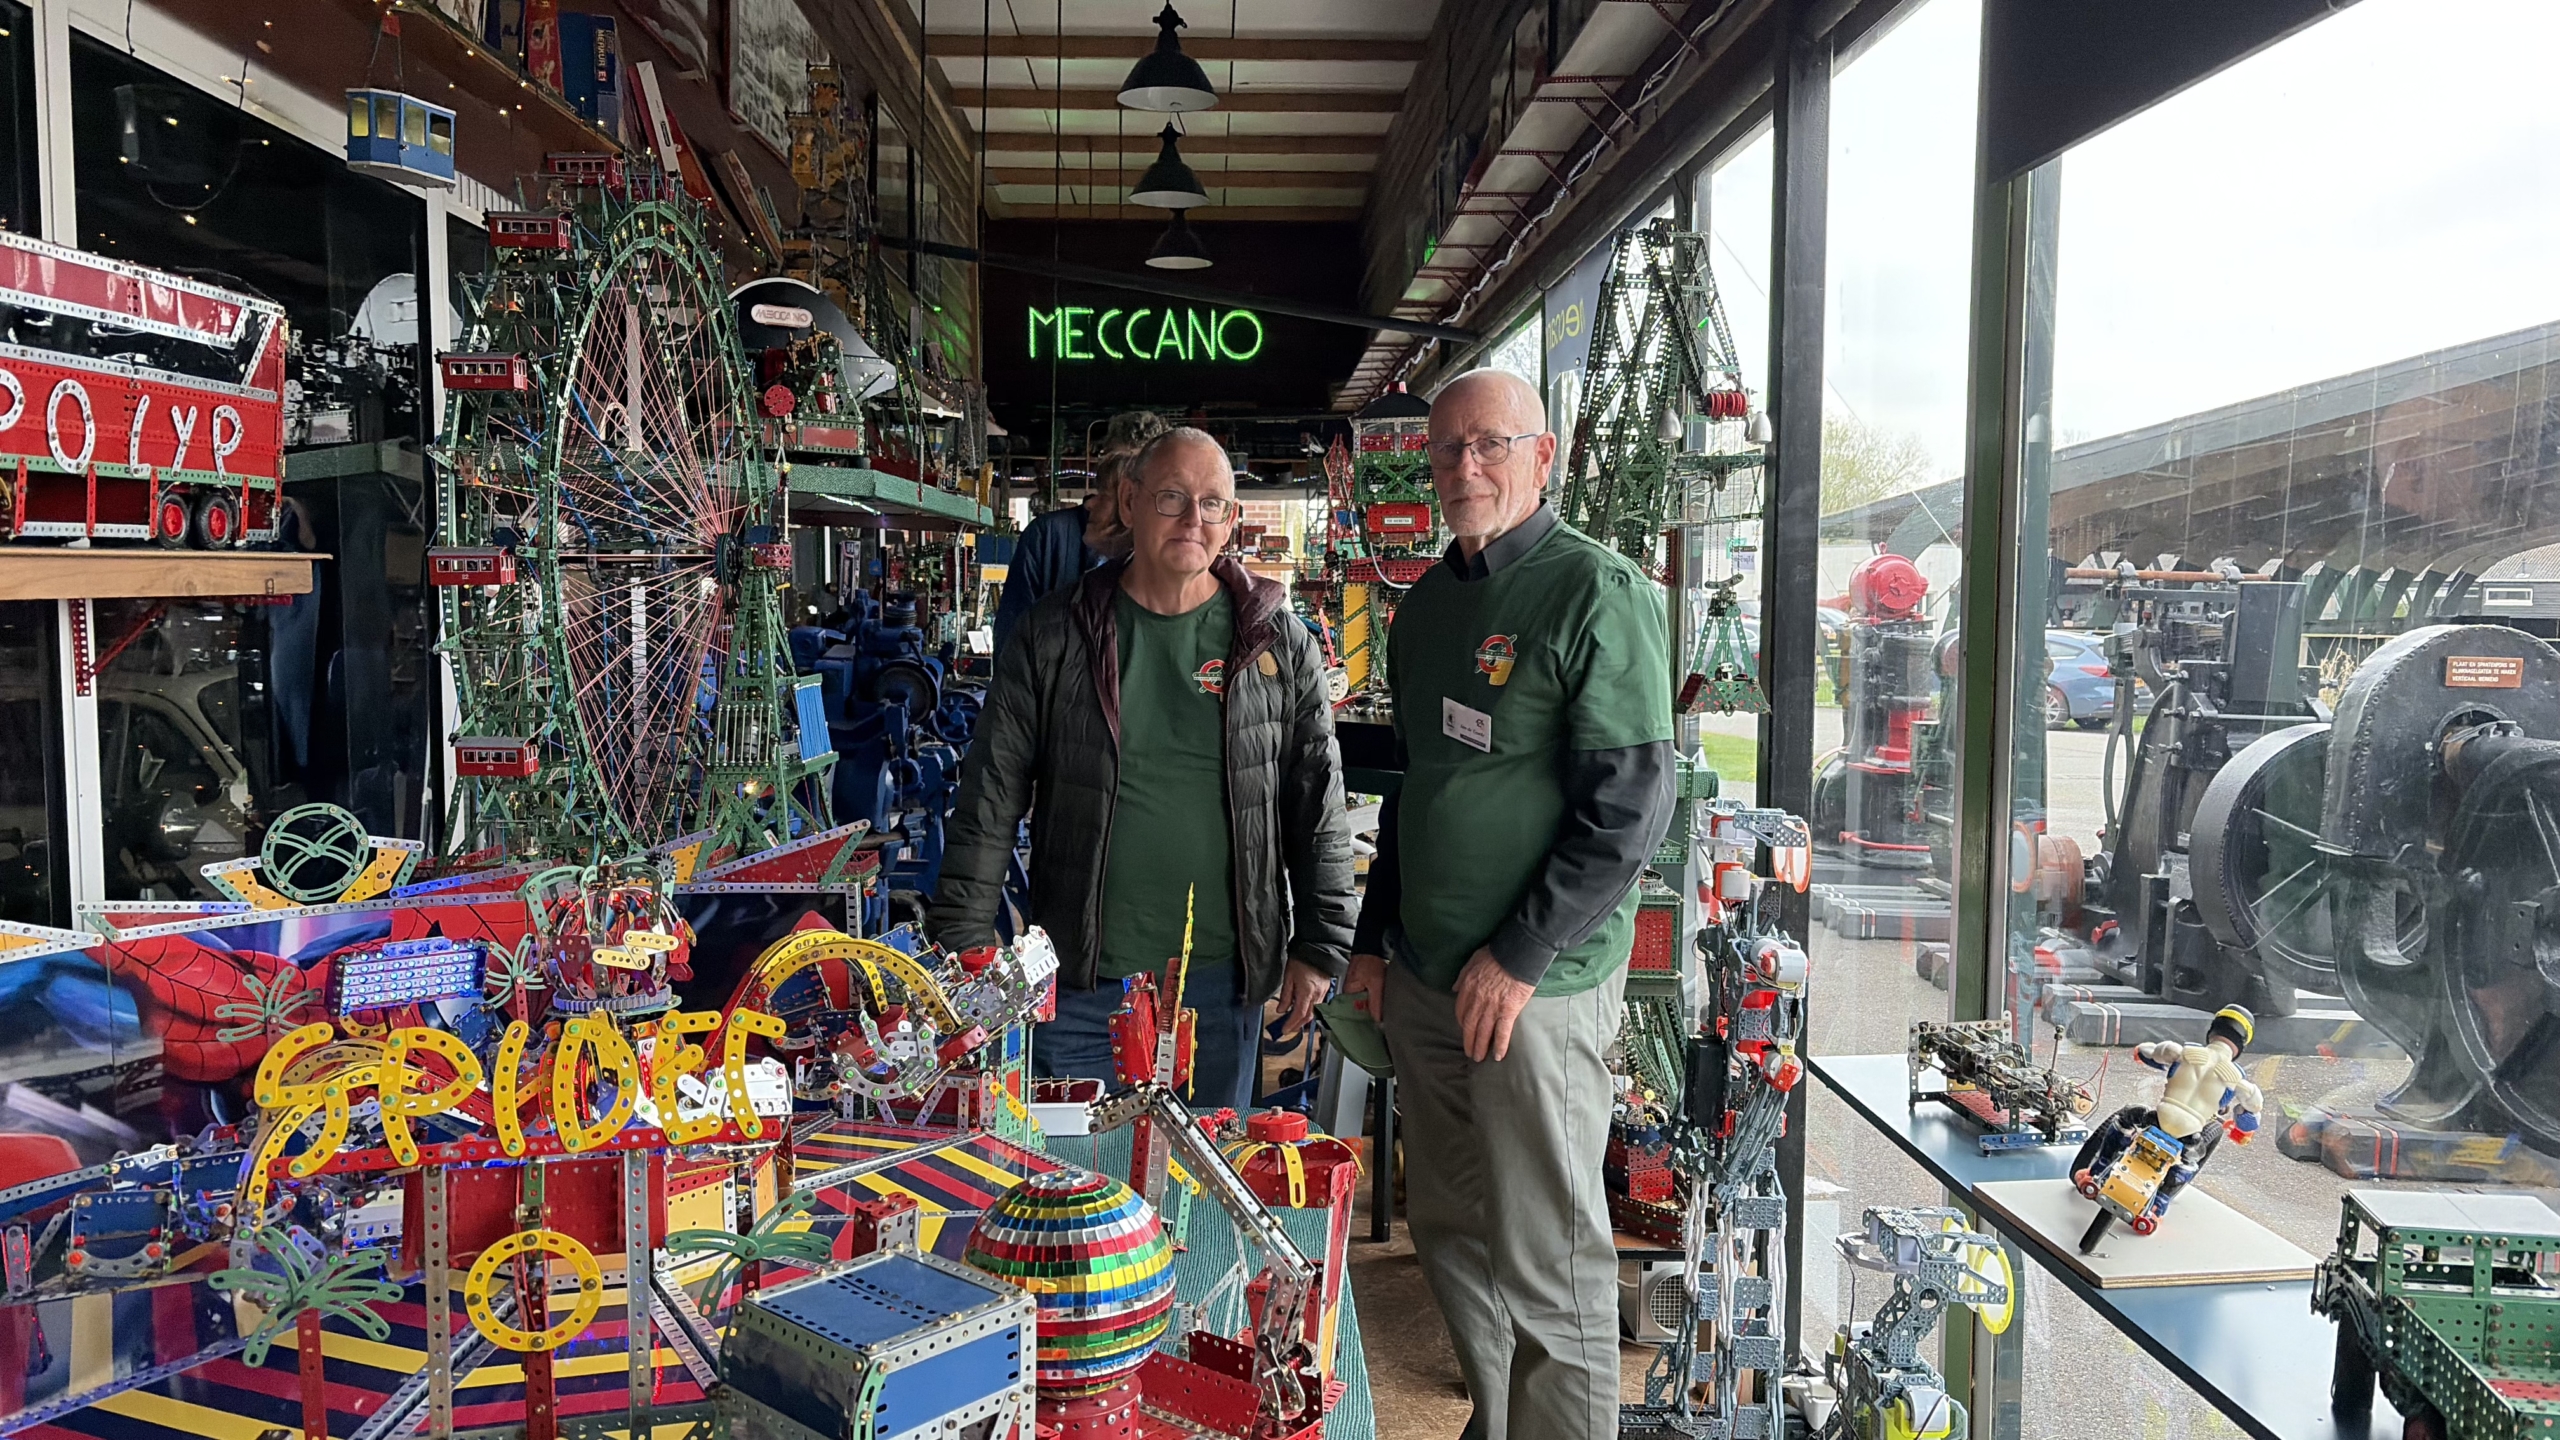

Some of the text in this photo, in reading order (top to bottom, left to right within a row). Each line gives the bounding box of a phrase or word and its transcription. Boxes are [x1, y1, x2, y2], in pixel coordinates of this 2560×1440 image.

[597, 30, 607, 81] MERKUR E1
[755, 308, 809, 323] MECCANO
[1028, 306, 1263, 361] MECCANO
